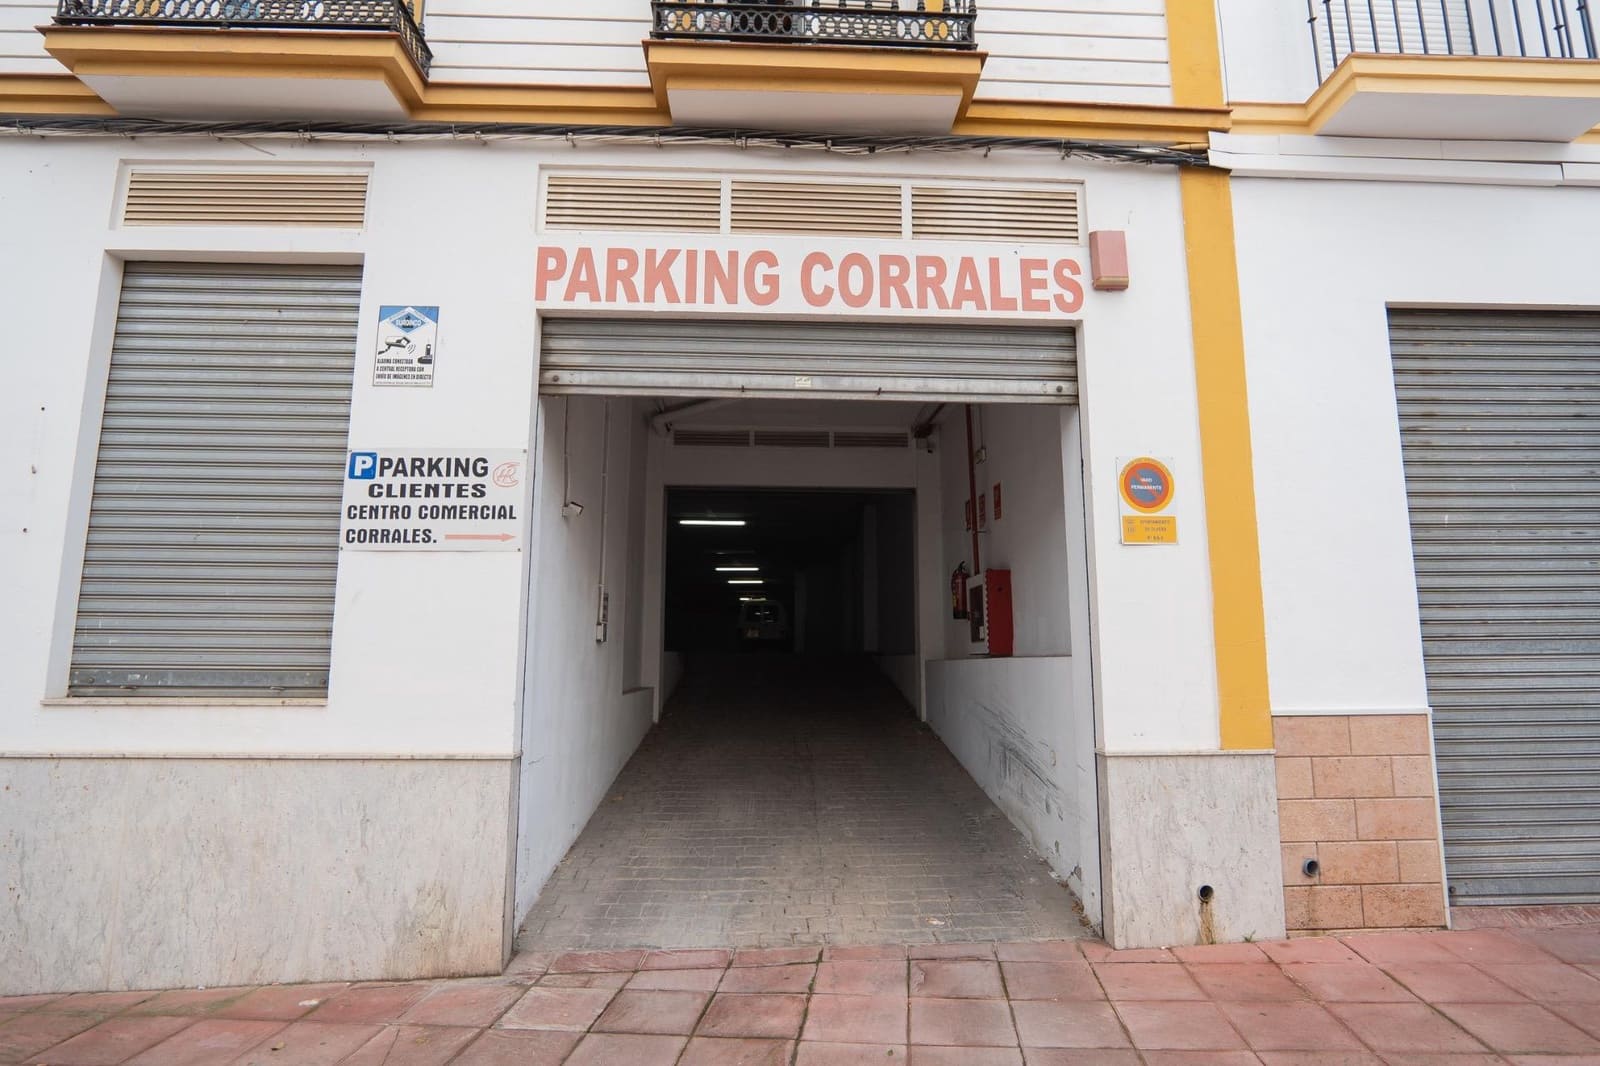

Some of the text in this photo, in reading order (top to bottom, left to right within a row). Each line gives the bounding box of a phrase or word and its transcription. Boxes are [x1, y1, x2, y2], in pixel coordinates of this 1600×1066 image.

[535, 246, 1084, 314] PARKING CORRALES
[354, 455, 373, 476] P
[379, 457, 489, 478] PARKING
[368, 483, 486, 498] CLIENTES
[347, 505, 517, 520] CENTRO COMERCIAL
[345, 528, 437, 544] CORRALES.
